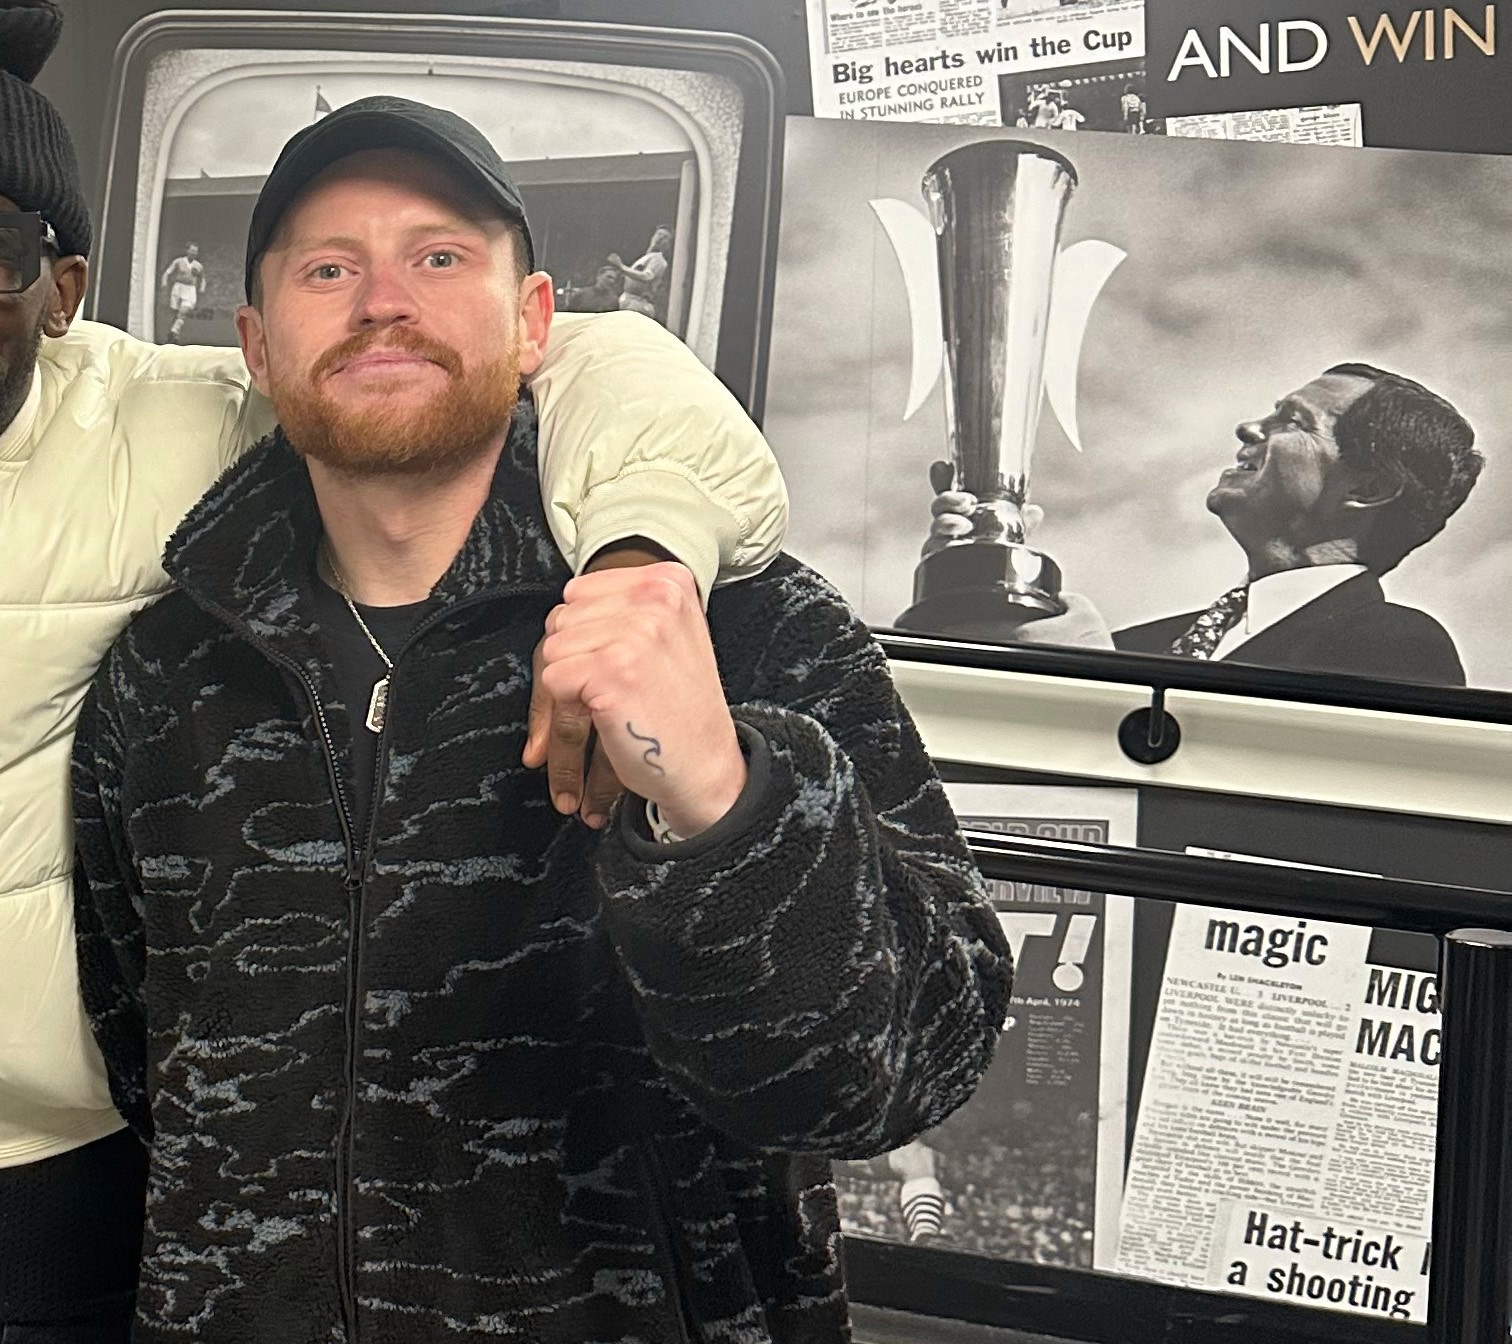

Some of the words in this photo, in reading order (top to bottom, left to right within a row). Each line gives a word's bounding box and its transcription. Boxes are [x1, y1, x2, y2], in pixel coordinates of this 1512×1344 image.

[832, 61, 874, 84] Big
[885, 50, 965, 77] hearts
[977, 43, 1018, 64] win
[1030, 36, 1071, 57] the
[1083, 28, 1133, 51] Cup
[1167, 20, 1328, 81] AND
[1347, 4, 1495, 66] WIN
[839, 86, 891, 105] EUROPE
[897, 75, 983, 97] CONQUERED
[860, 98, 934, 120] STUNNING
[940, 92, 985, 109] RALLY
[1205, 918, 1328, 968] magic
[1055, 997, 1080, 1007] 1974
[1166, 976, 1226, 994] NEWCASTLE
[1355, 1018, 1442, 1066] MAC
[1244, 1210, 1403, 1272] Hat-trick
[1227, 1260, 1249, 1286] a
[1267, 1262, 1415, 1320] shooting
